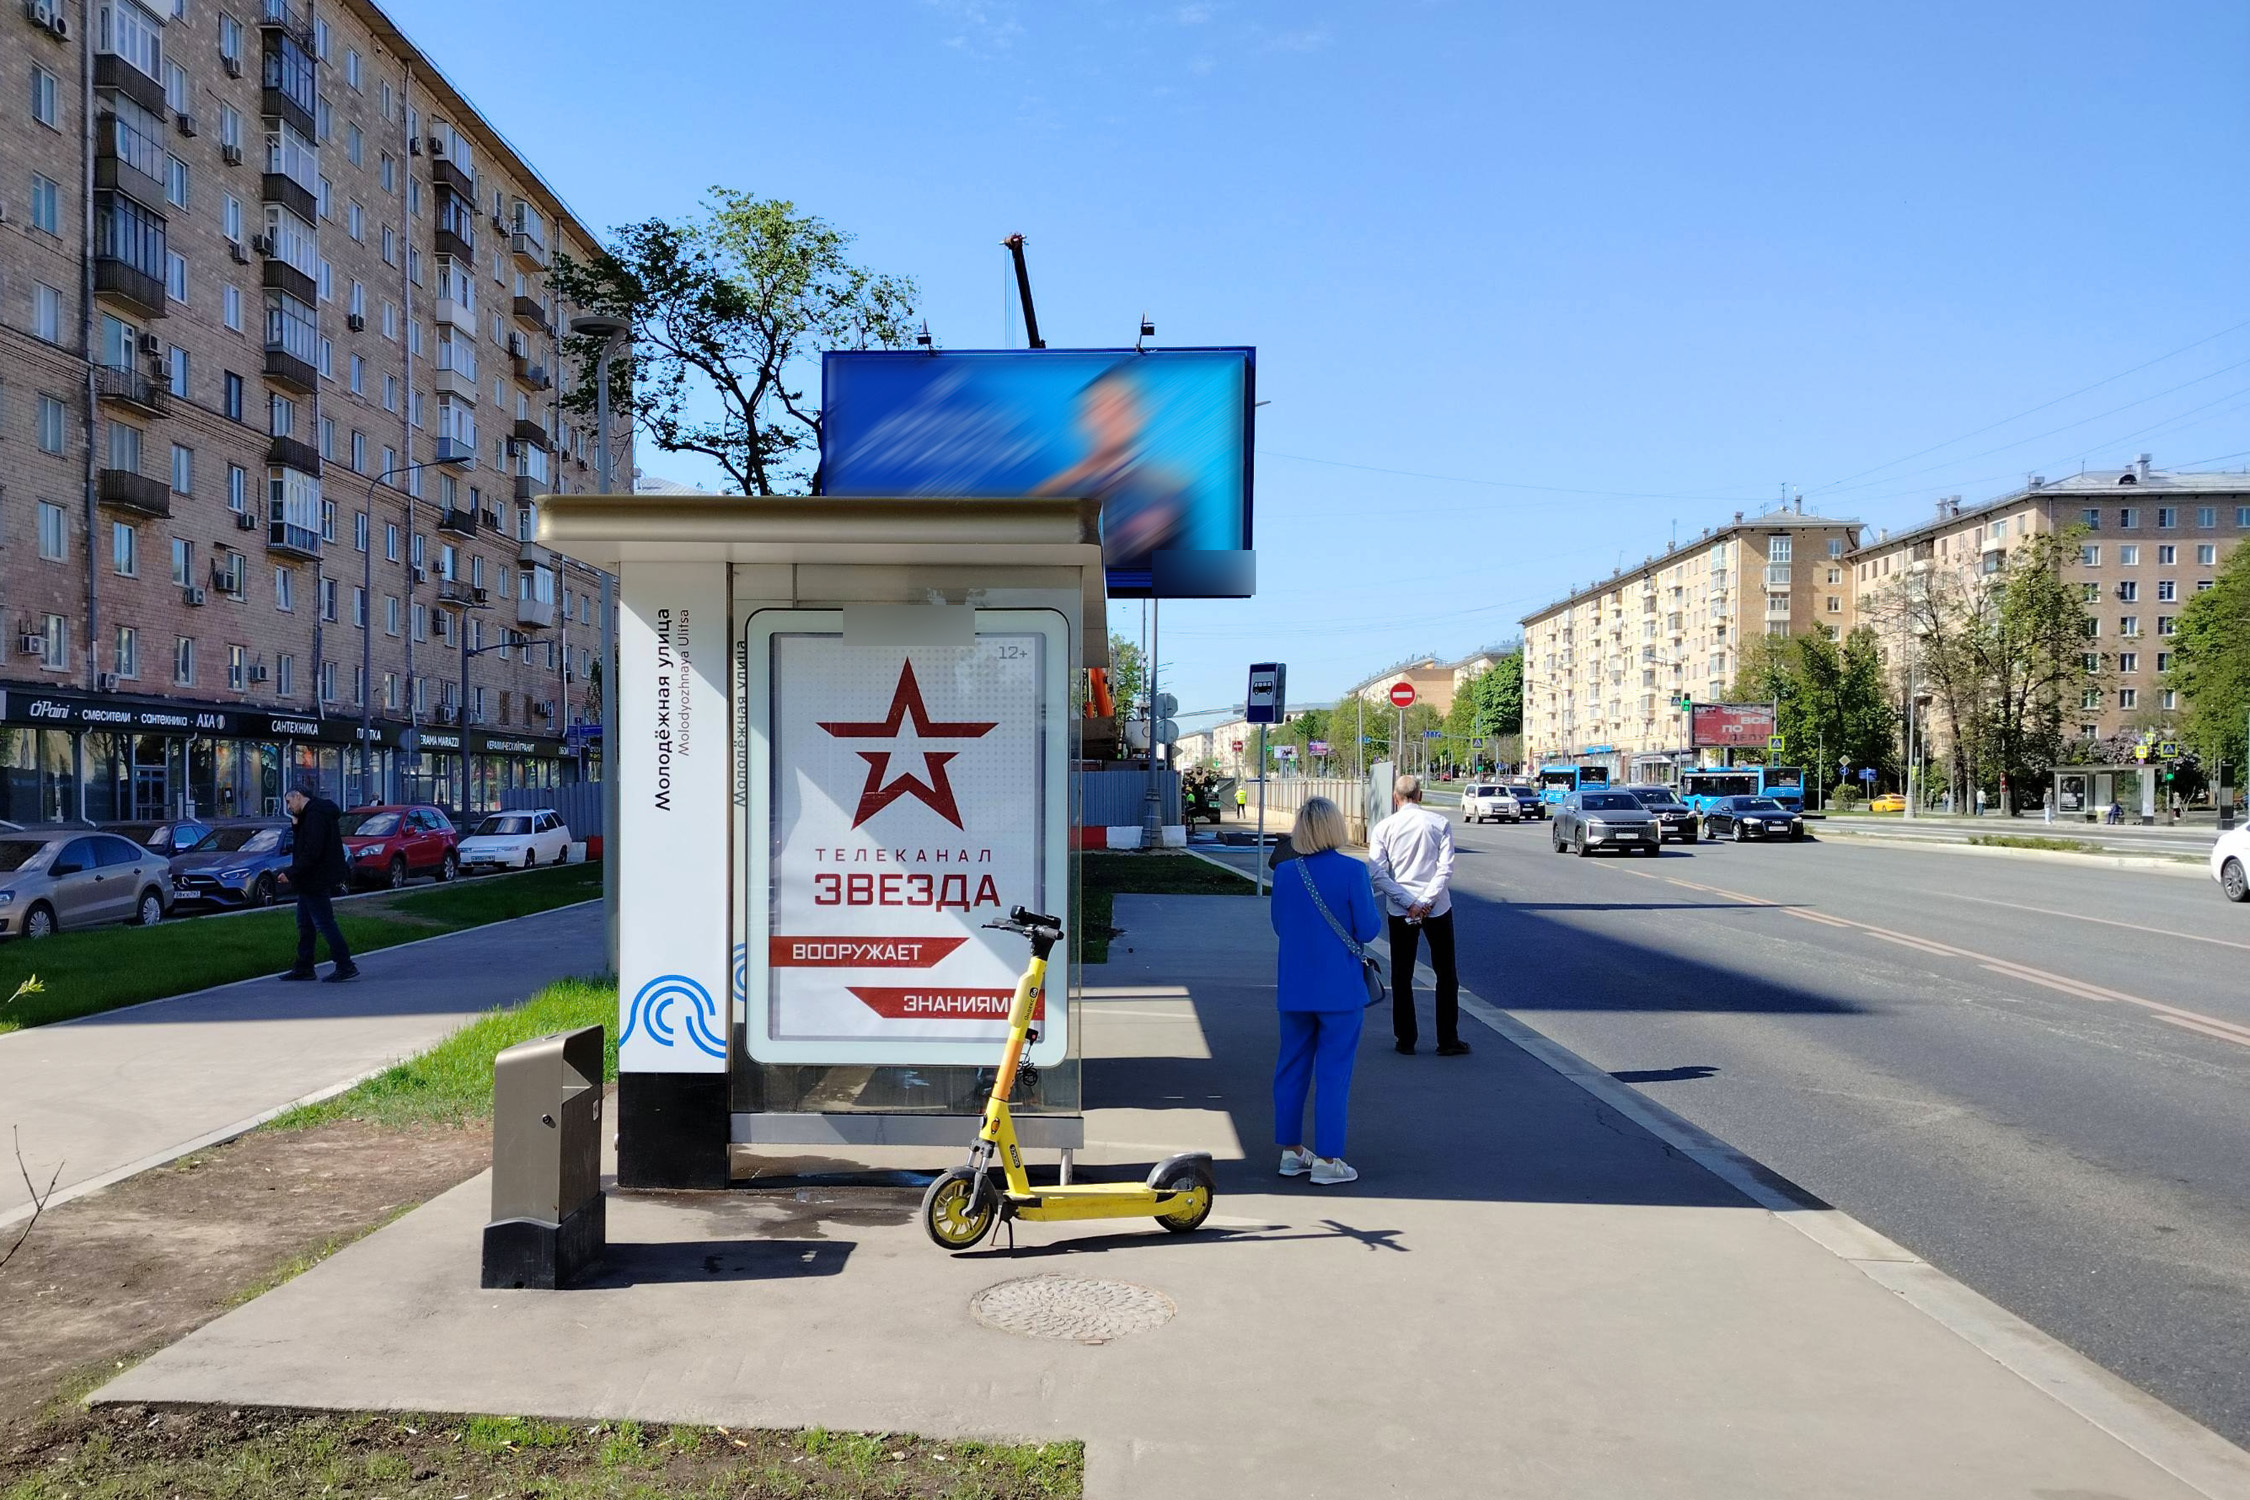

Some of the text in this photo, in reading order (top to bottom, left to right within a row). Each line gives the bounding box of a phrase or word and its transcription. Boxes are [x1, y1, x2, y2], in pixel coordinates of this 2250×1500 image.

[999, 646, 1028, 659] 12+
[677, 609, 692, 756] Molodyozhnaya Ulitsa
[41, 700, 70, 718] Paini
[655, 608, 674, 811] Молодёжная улица
[82, 709, 187, 726] смесители сантехника
[271, 720, 319, 735] САНТЕХНИКА
[356, 728, 381, 741] ПЛТКА
[1721, 725, 1743, 733] ПО
[815, 848, 991, 862] ТЕЛЕКАНАЛ
[815, 873, 1001, 912] ЗВЕЗДА
[792, 944, 922, 960] ВООРУЖАЕТ
[903, 995, 1013, 1013] ЗНАНИЯМ
